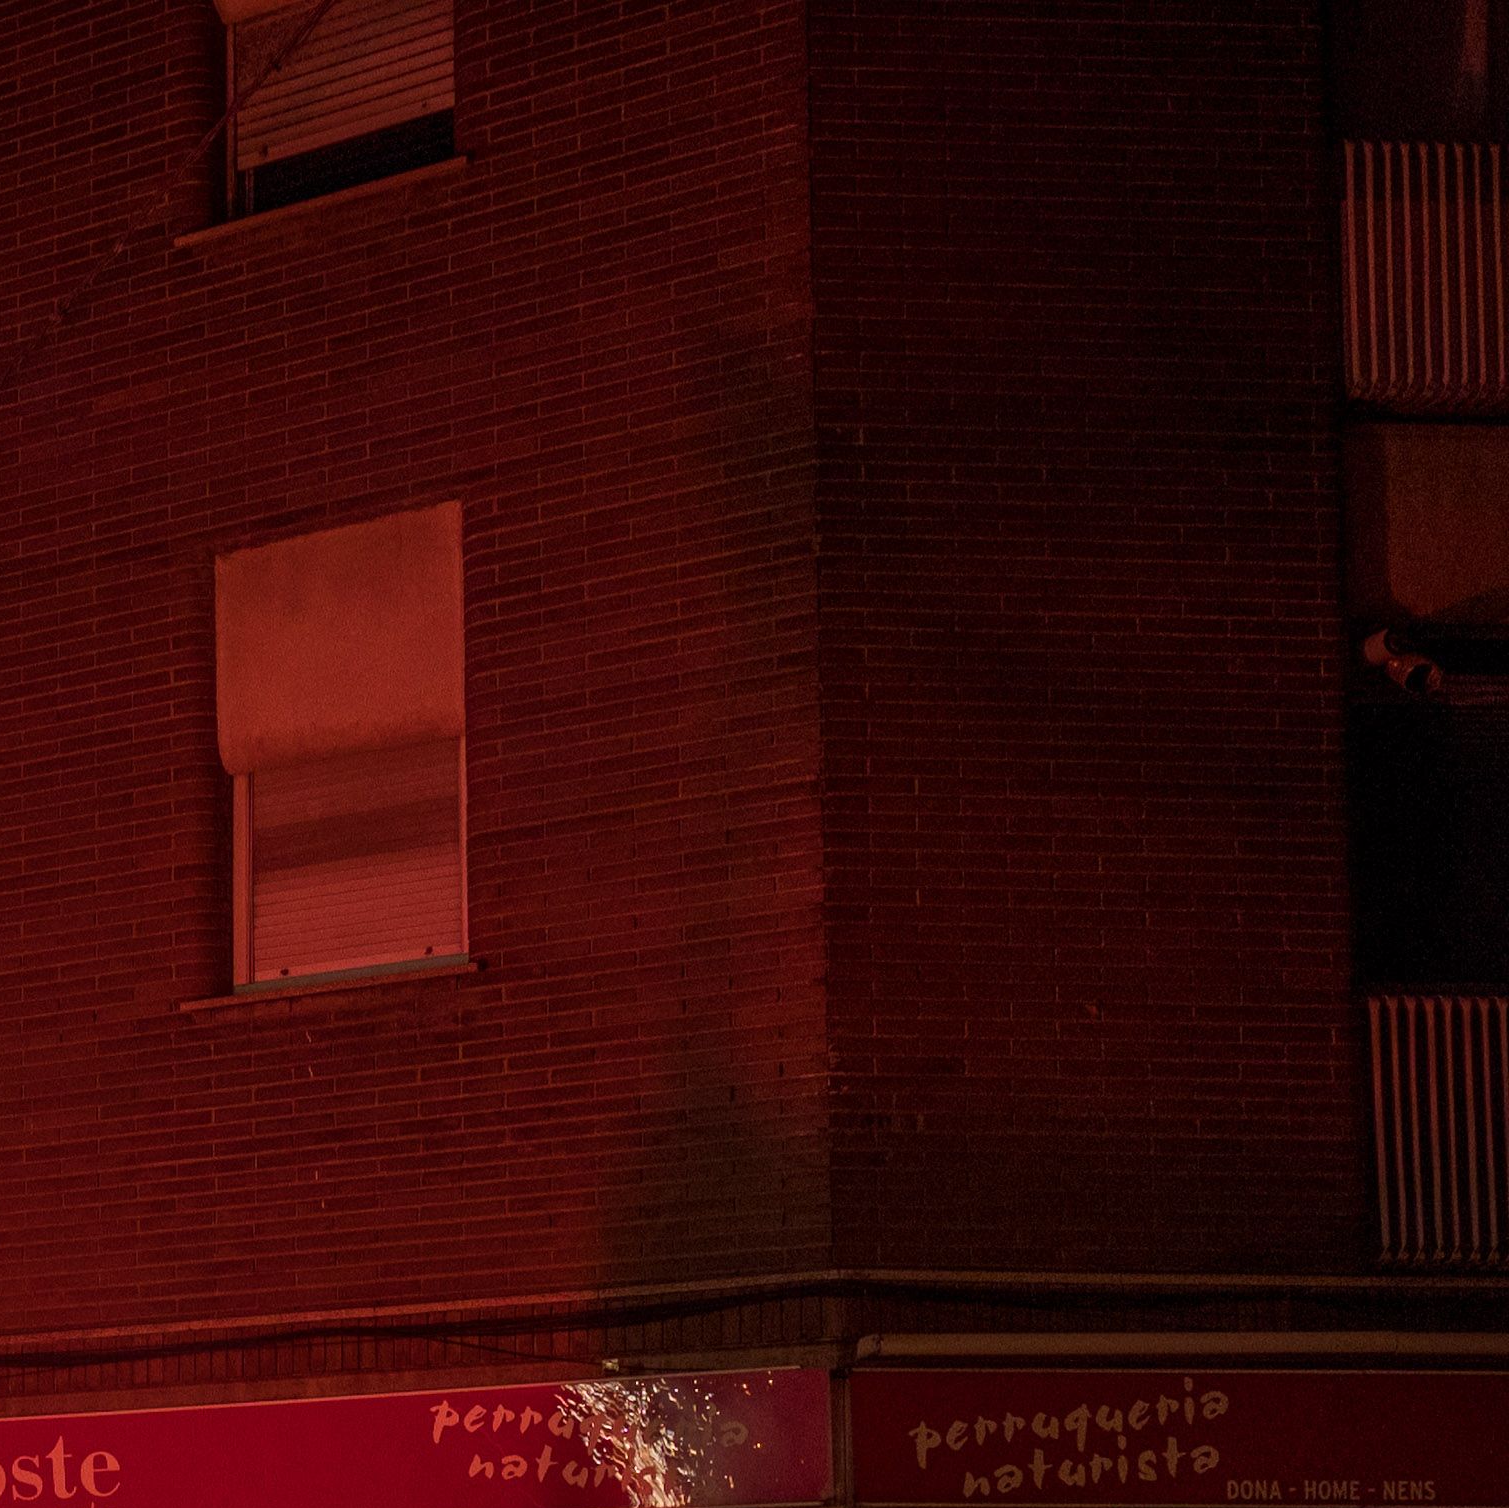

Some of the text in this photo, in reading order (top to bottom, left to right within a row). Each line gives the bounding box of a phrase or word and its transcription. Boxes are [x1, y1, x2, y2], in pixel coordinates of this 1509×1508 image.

[908, 1376, 1230, 1470] perruqueria
[961, 1434, 1221, 1499] naturista
[1226, 1479, 1283, 1500] DONA
[1304, 1479, 1361, 1501] HOME
[1382, 1479, 1437, 1501] NENS
